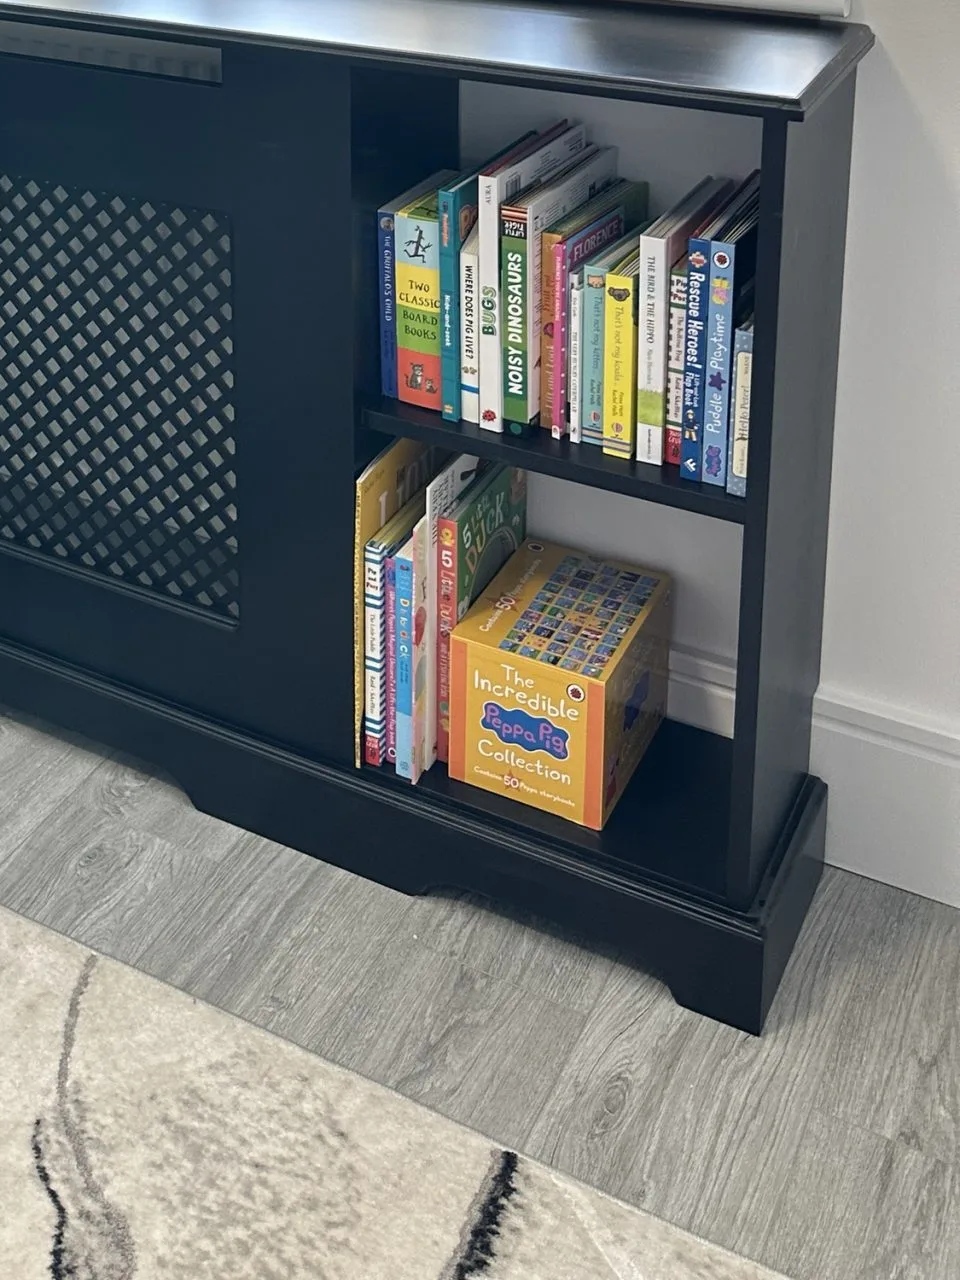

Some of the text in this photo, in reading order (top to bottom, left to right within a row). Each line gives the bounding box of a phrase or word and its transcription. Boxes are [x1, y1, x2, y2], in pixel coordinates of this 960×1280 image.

[574, 220, 619, 261] FLORENCE
[408, 280, 430, 292] TWO
[647, 272, 655, 295] BIRD
[399, 292, 441, 308] CLASSIC
[465, 265, 474, 359] WHERE DOES PIG LIVE?
[482, 286, 496, 336] BUGS
[647, 302, 655, 317] THE
[402, 310, 438, 326] BOARD
[507, 252, 523, 395] NOISY DINOSAURS
[646, 318, 654, 343] HIPPO
[686, 272, 705, 369] Rescue Heroes!
[404, 325, 437, 340] BOOKS
[709, 313, 727, 370] Playtime
[685, 371, 695, 406] Flap Book
[706, 392, 722, 433] Puddle
[463, 523, 472, 549] 5
[442, 550, 453, 568] 5
[496, 596, 516, 611] 50
[500, 663, 535, 689] The
[474, 669, 579, 721] Incredible
[485, 704, 566, 757] Peppa Pig
[478, 739, 571, 785] Collection
[503, 775, 520, 789] 50
